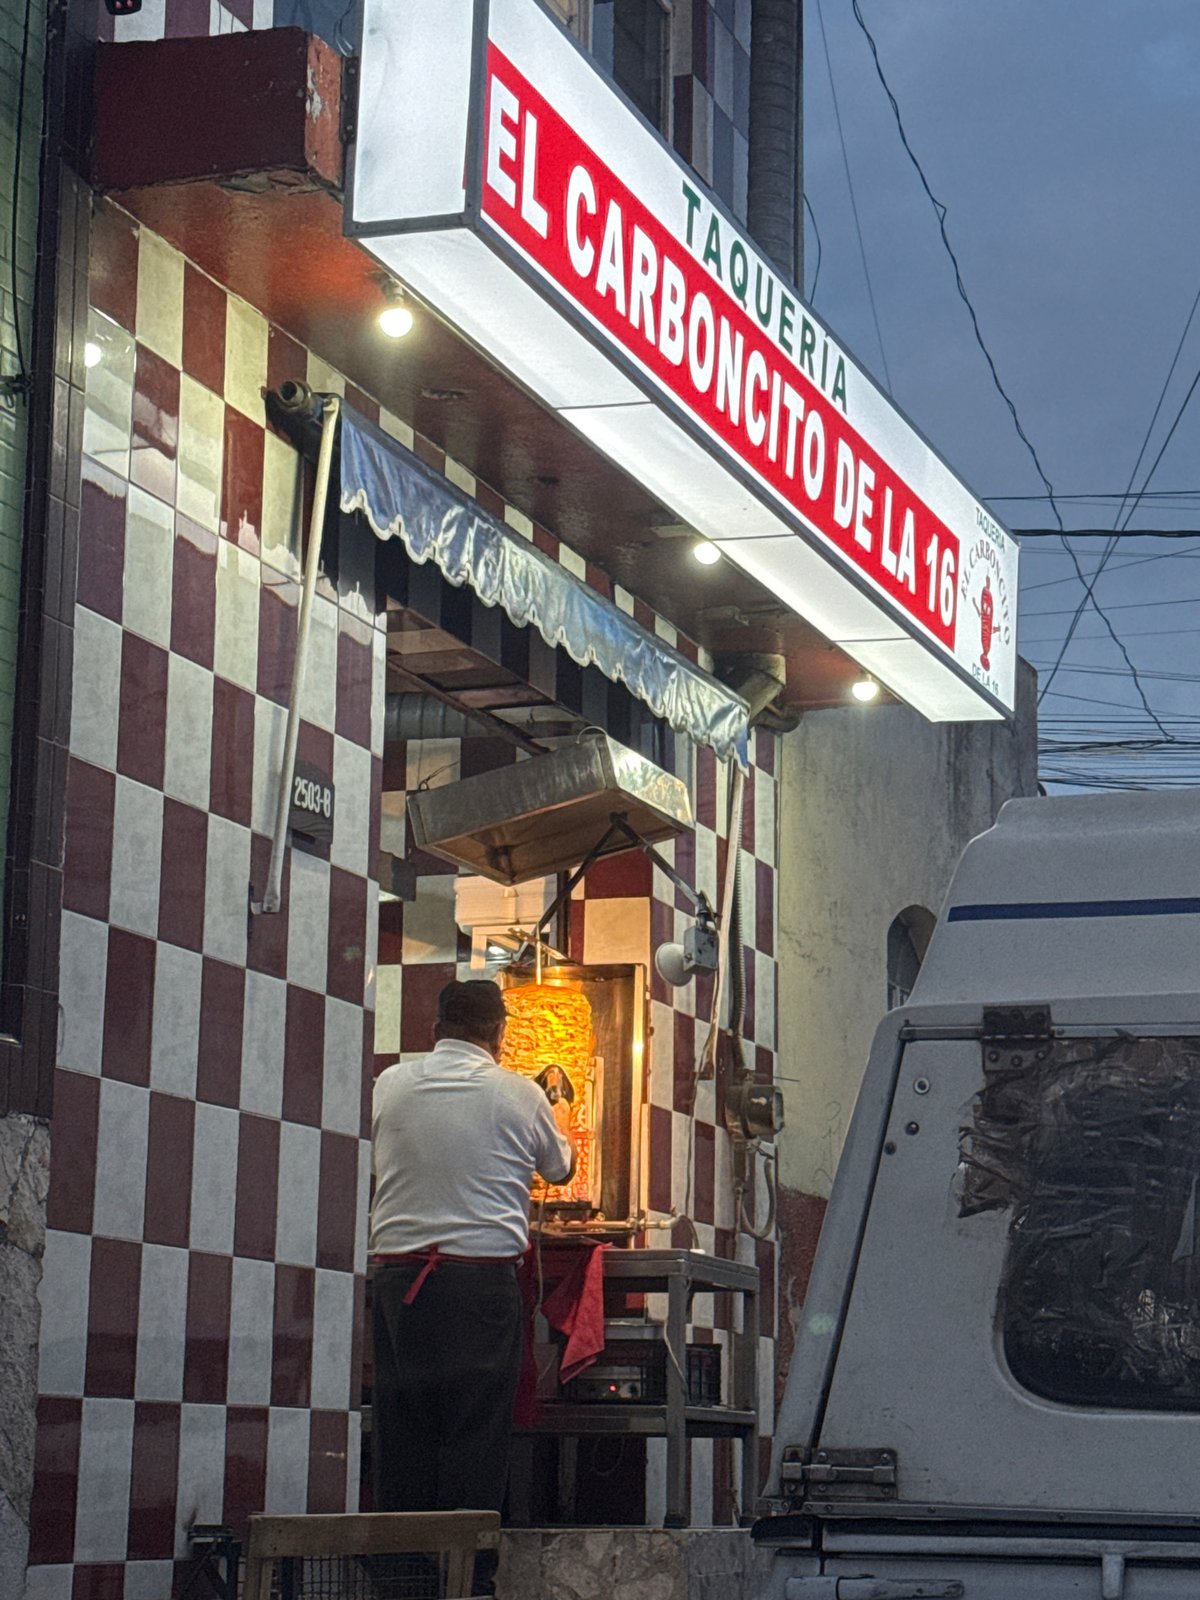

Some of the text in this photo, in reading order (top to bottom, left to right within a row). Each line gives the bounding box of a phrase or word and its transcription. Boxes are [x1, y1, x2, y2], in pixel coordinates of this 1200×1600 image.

[487, 73, 955, 627] EL CARBONCITO DE LA 16
[960, 538, 1010, 646] EL CARBONCITO
[972, 662, 999, 696] DE LA 16
